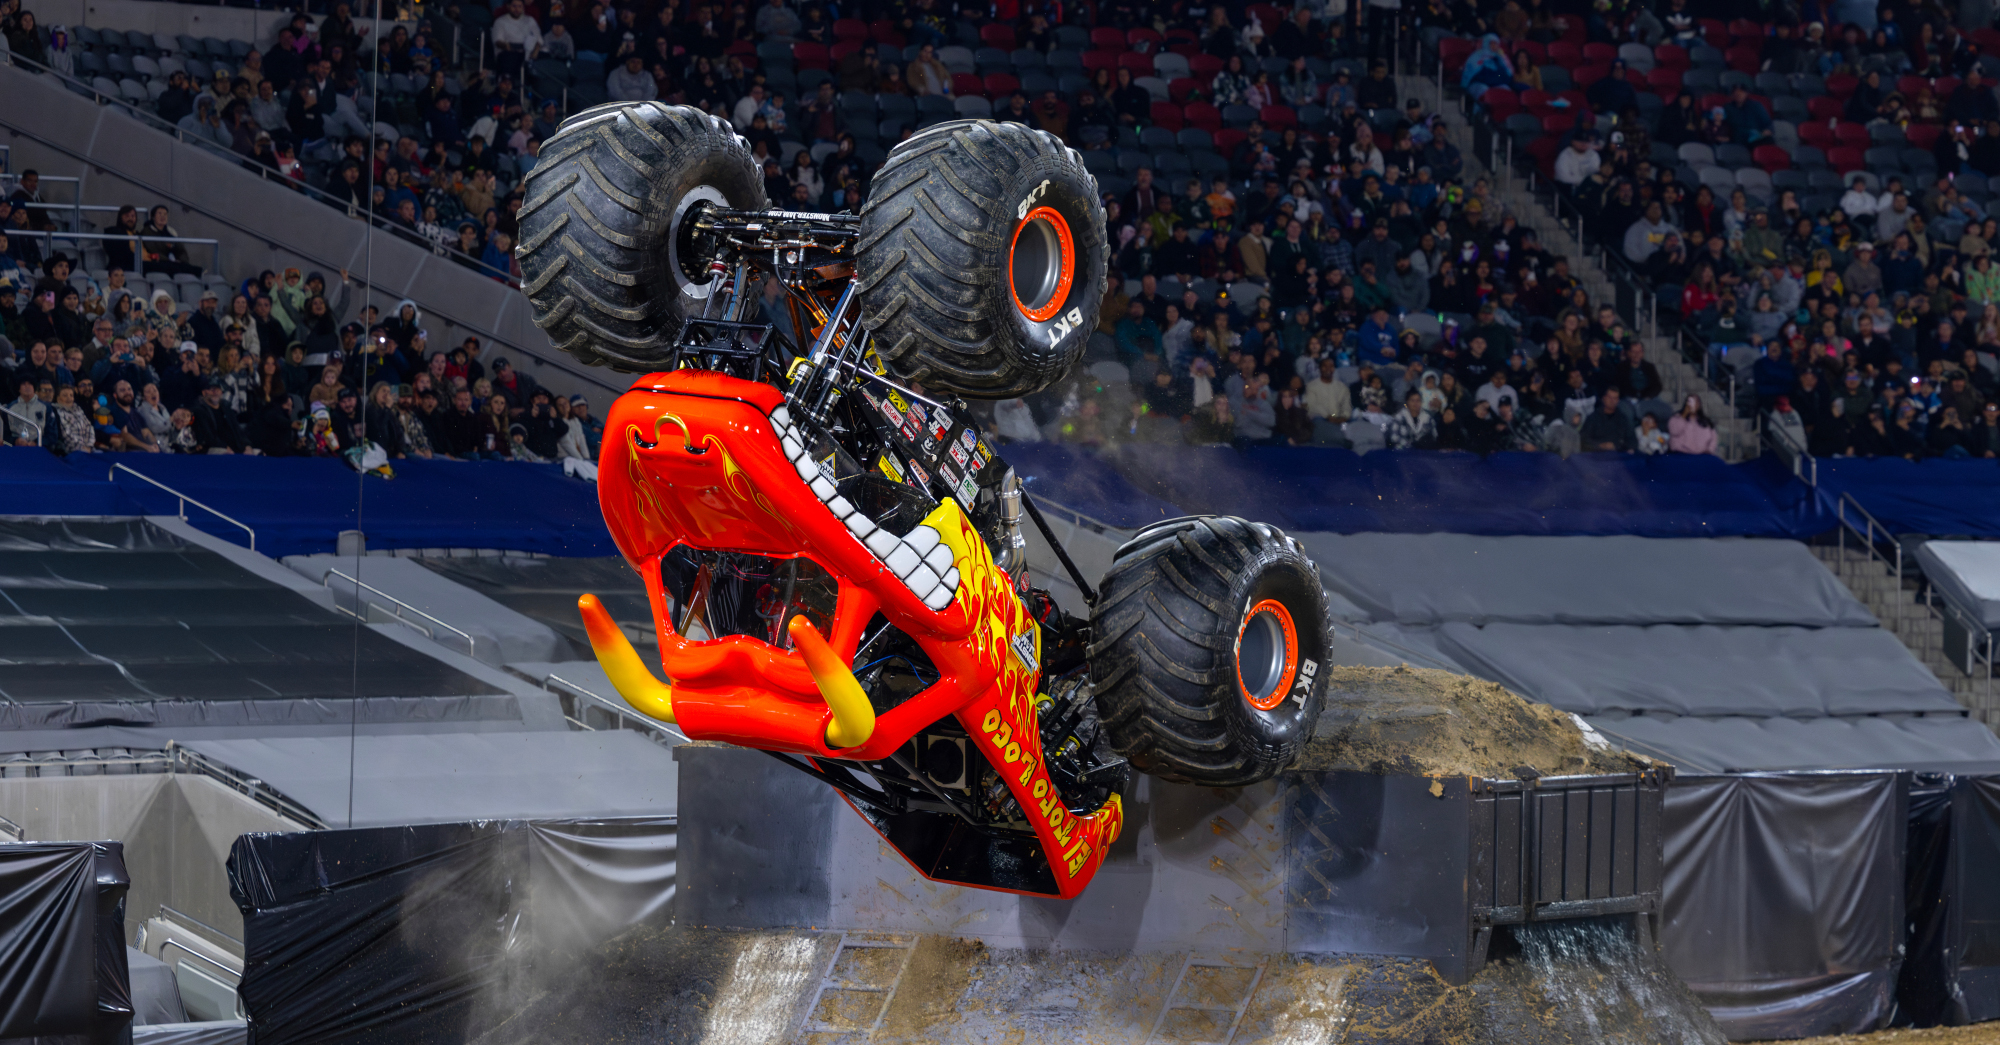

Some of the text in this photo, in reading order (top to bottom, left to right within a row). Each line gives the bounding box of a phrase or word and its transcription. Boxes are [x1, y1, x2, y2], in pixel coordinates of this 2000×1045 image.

[1018, 179, 1050, 220] BKT
[1048, 306, 1083, 349] BKT
[883, 402, 902, 425] SIMPSON
[977, 441, 992, 463] UNOH
[814, 460, 840, 488] MONSTER
[821, 460, 835, 476] JAM
[1012, 632, 1039, 671] MONSTER
[1020, 634, 1035, 653] JAM
[1292, 658, 1318, 710] BKT
